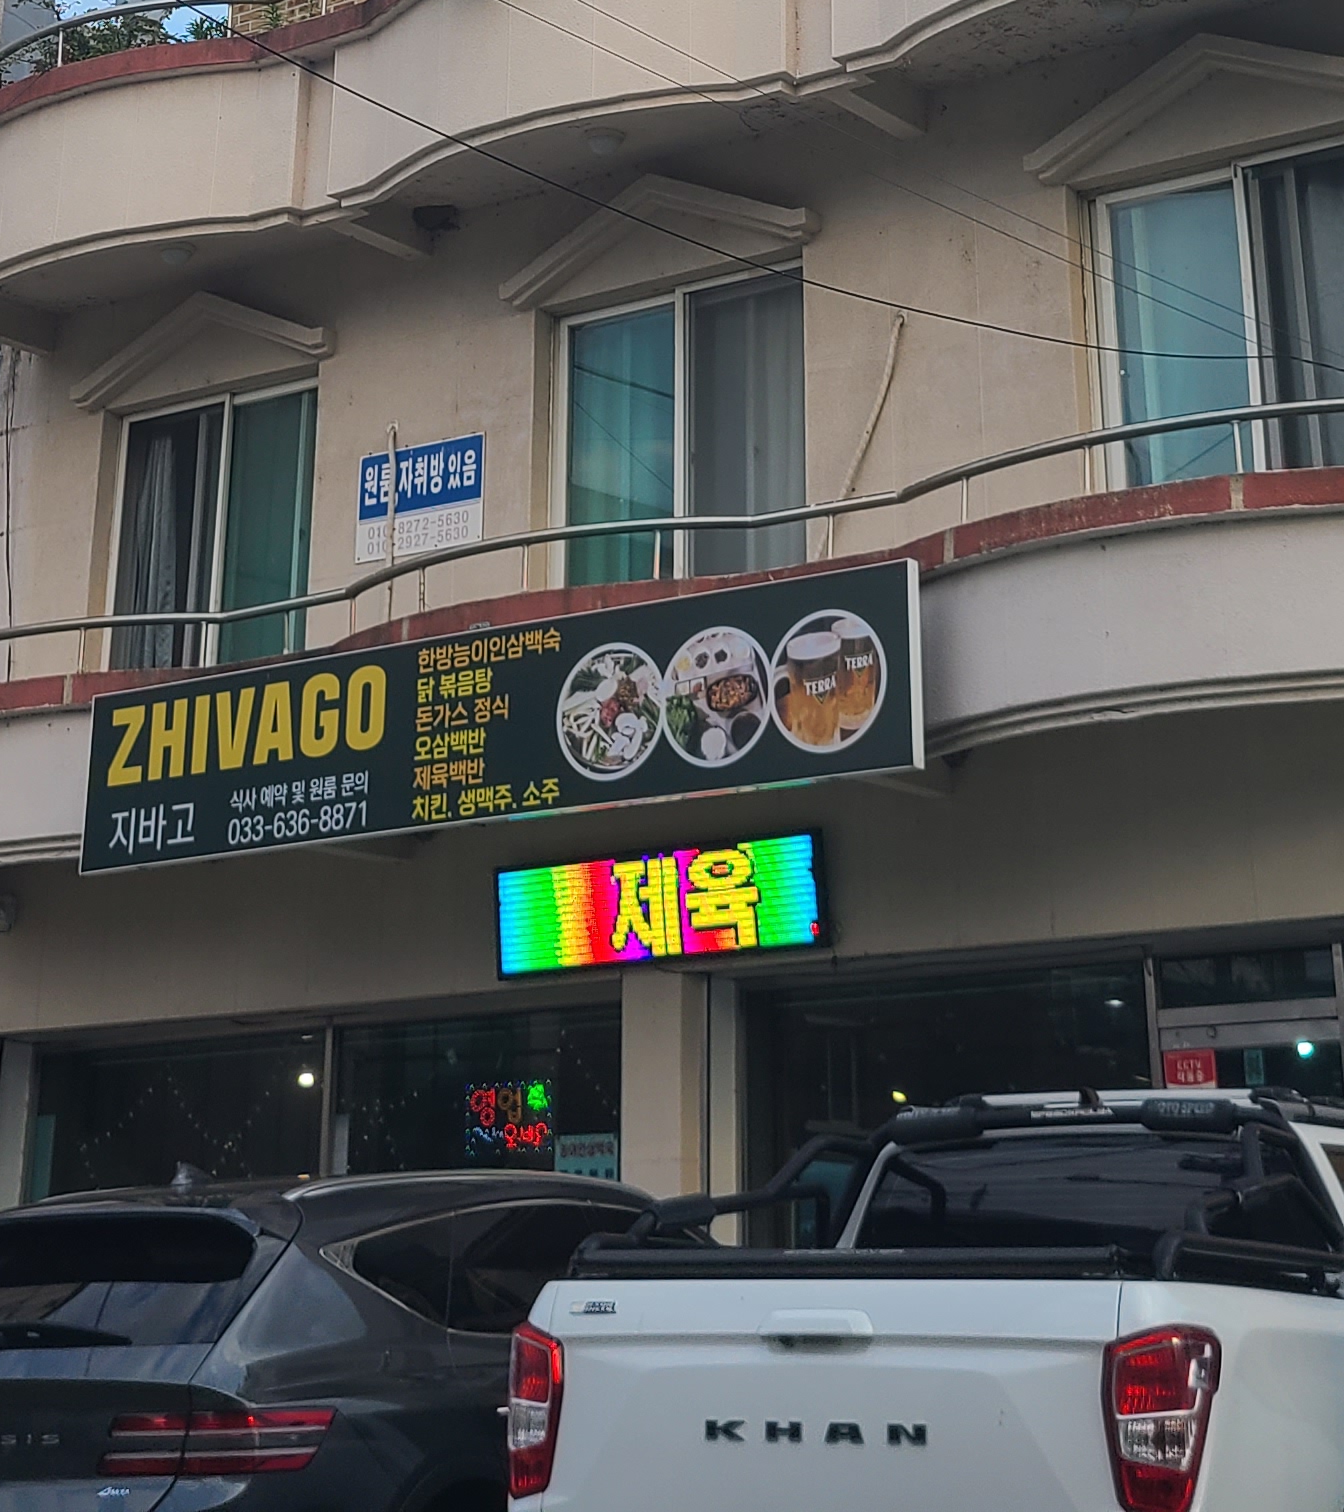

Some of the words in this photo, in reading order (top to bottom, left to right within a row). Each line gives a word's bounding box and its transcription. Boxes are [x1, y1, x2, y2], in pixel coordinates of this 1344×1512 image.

[447, 449, 477, 490] 있음
[417, 626, 562, 674] 한방능이인삼백숙
[844, 653, 874, 671] TERRA
[416, 676, 435, 703] 닭
[439, 667, 493, 699] 볶음탕
[804, 674, 837, 696] TERRA
[107, 664, 387, 787] ZHIVAGO
[415, 701, 469, 732] 돈가스
[474, 693, 510, 723] 정식
[414, 727, 486, 761] 오삼백반
[229, 787, 257, 813] 식사
[259, 783, 288, 809] 예약
[291, 779, 306, 803] 및
[309, 776, 337, 802] 원룸
[340, 770, 369, 796] 문의
[412, 757, 486, 790] 제육백반
[522, 778, 561, 807] 소주
[109, 802, 196, 855] 지바고
[227, 800, 368, 845] 033-636-8871
[611, 847, 760, 957] 제육
[705, 1418, 928, 1446] KHAN
